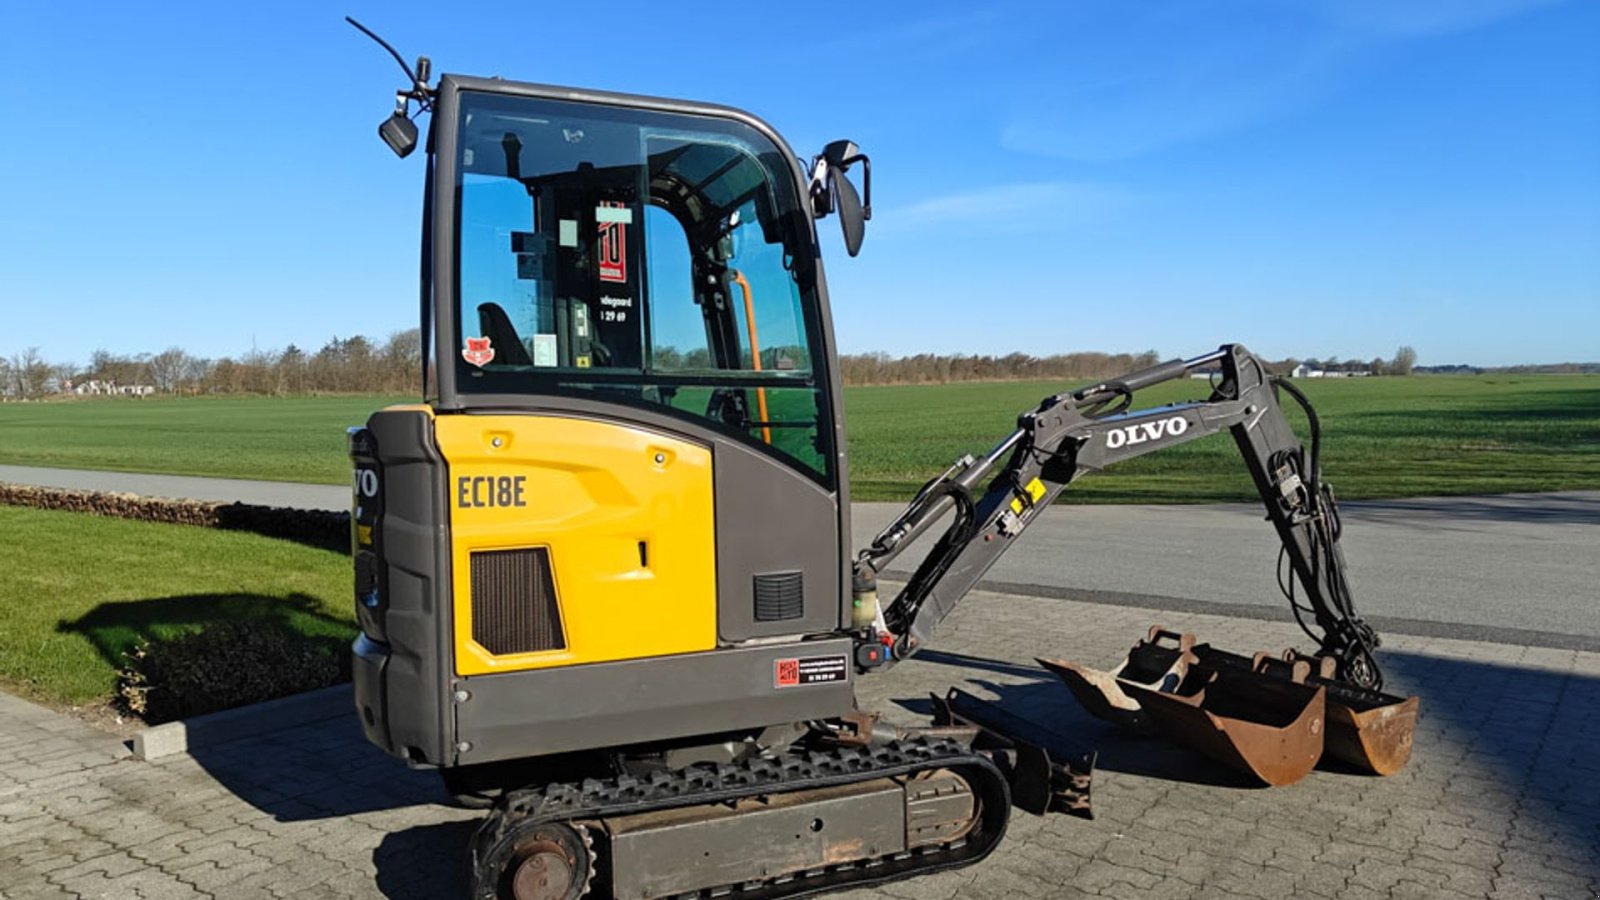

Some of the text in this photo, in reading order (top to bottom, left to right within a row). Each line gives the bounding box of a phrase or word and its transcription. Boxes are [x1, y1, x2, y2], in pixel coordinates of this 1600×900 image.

[605, 310, 616, 321] 29
[616, 311, 626, 322] 69
[1106, 416, 1187, 448] OLVO
[458, 476, 526, 508] EC18E
